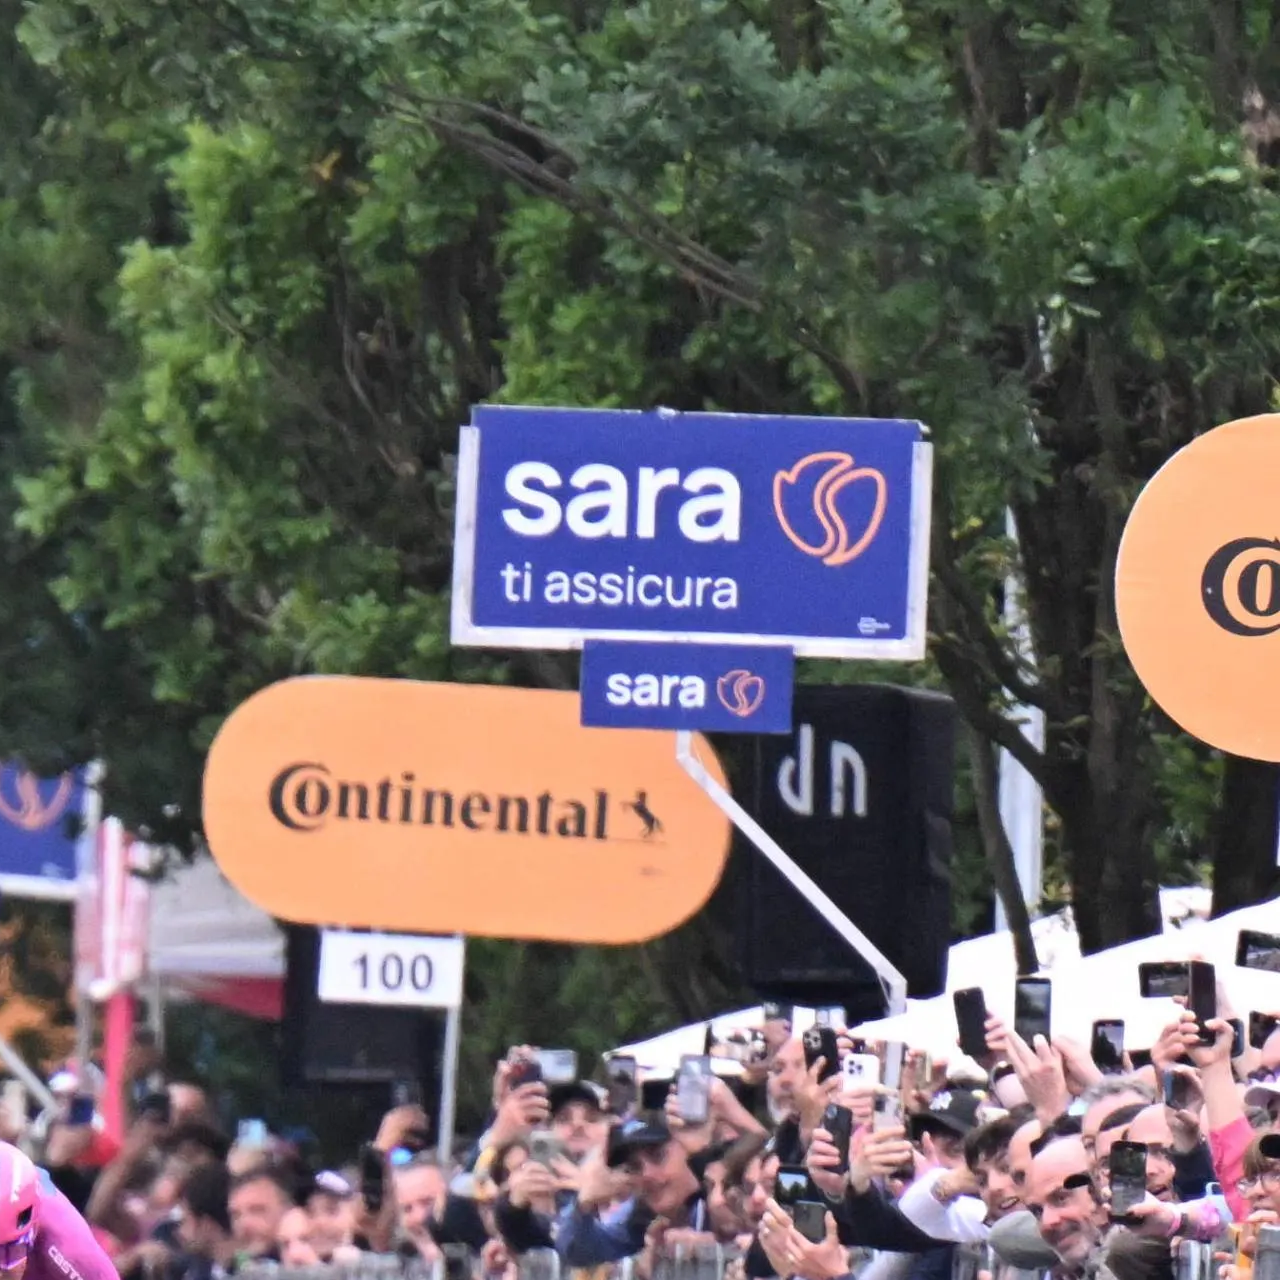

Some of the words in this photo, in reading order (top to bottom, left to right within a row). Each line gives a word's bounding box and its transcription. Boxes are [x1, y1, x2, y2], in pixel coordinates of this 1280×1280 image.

[501, 460, 741, 543] sara
[501, 561, 532, 603] ti
[544, 566, 738, 610] assicura
[606, 672, 706, 709] sara
[268, 761, 611, 841] Continental
[351, 951, 435, 991] 100
